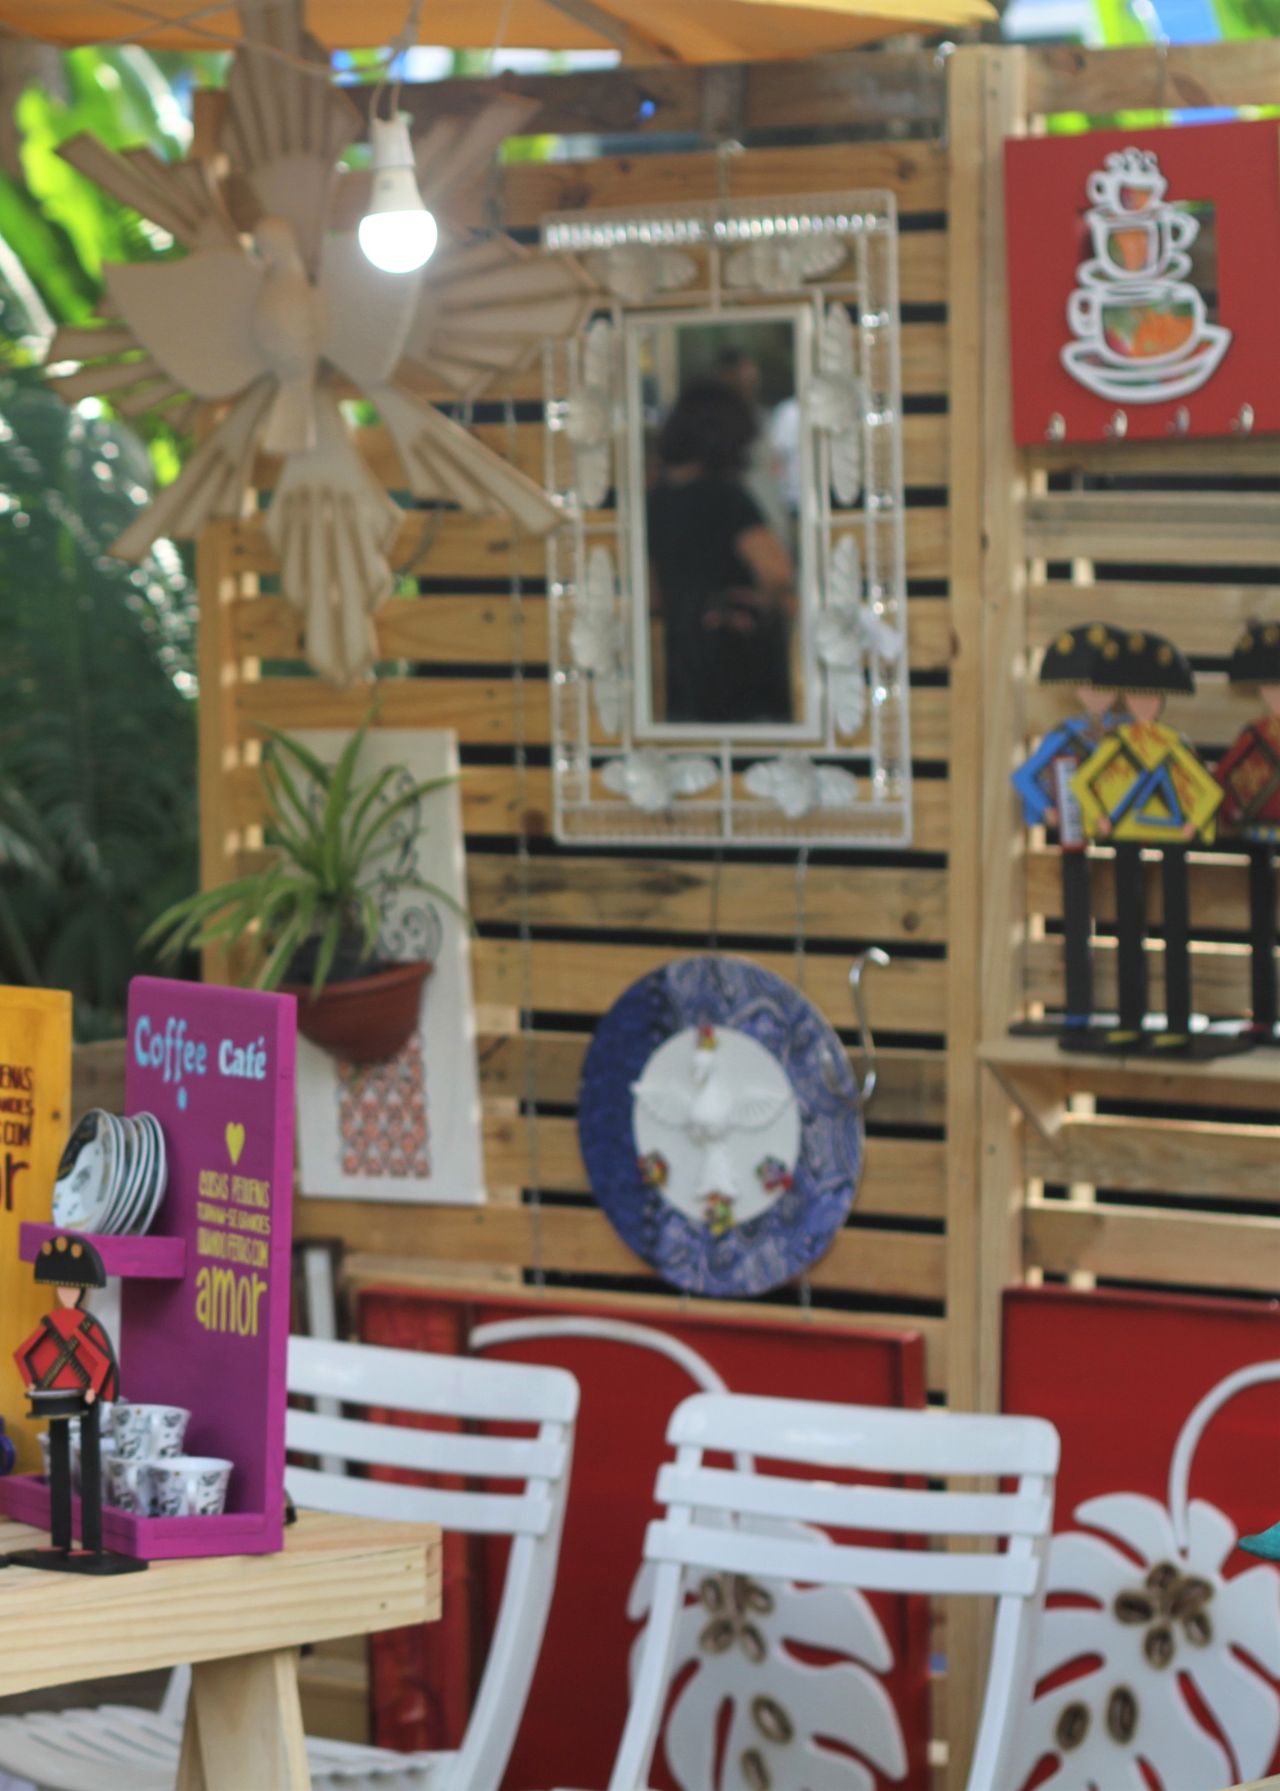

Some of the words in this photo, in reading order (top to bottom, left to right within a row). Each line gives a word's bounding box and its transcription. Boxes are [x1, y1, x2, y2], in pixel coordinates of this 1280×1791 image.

[134, 1014, 208, 1084] Coffee
[218, 1036, 267, 1081] Café
[196, 1265, 268, 1337] amor
